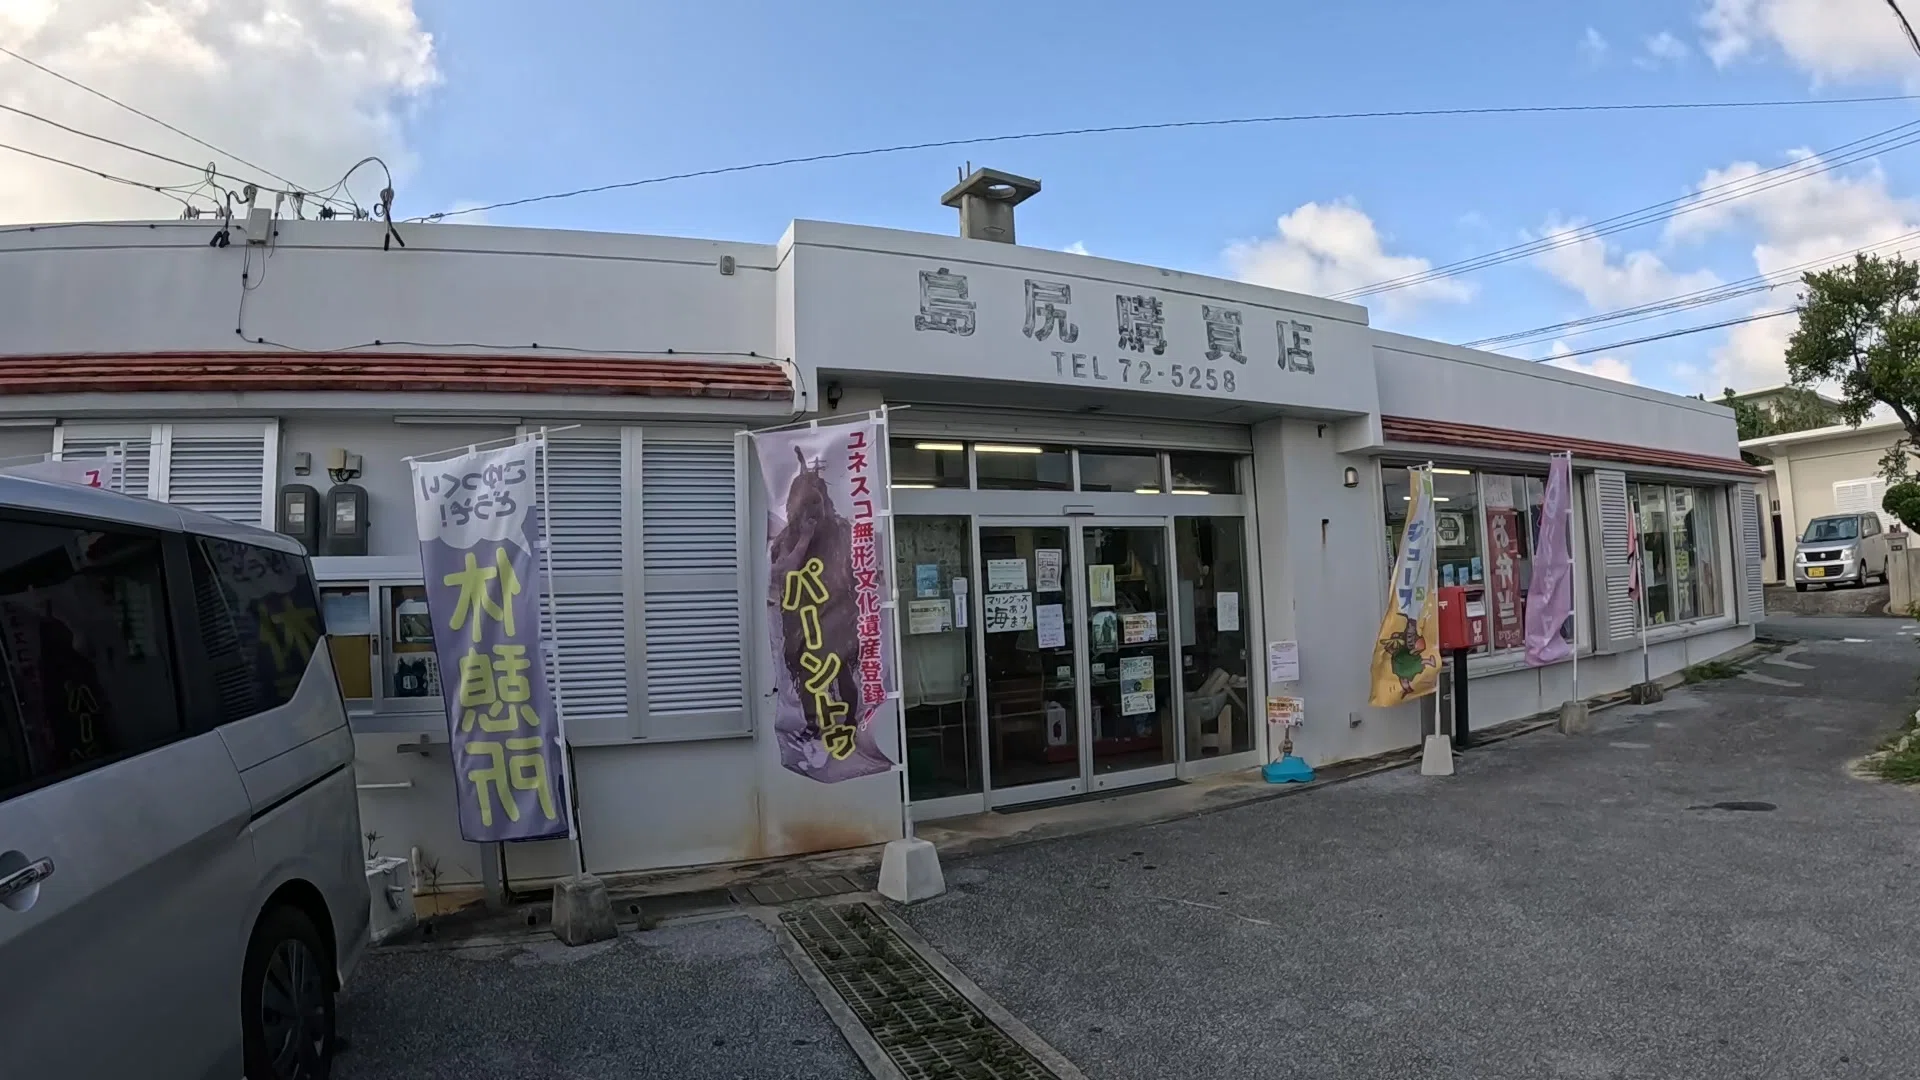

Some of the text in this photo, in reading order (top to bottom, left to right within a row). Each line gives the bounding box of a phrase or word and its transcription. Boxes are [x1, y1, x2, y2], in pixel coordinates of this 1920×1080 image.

[1051, 351, 1236, 393] TEL 72-5258
[986, 606, 1010, 630] 海
